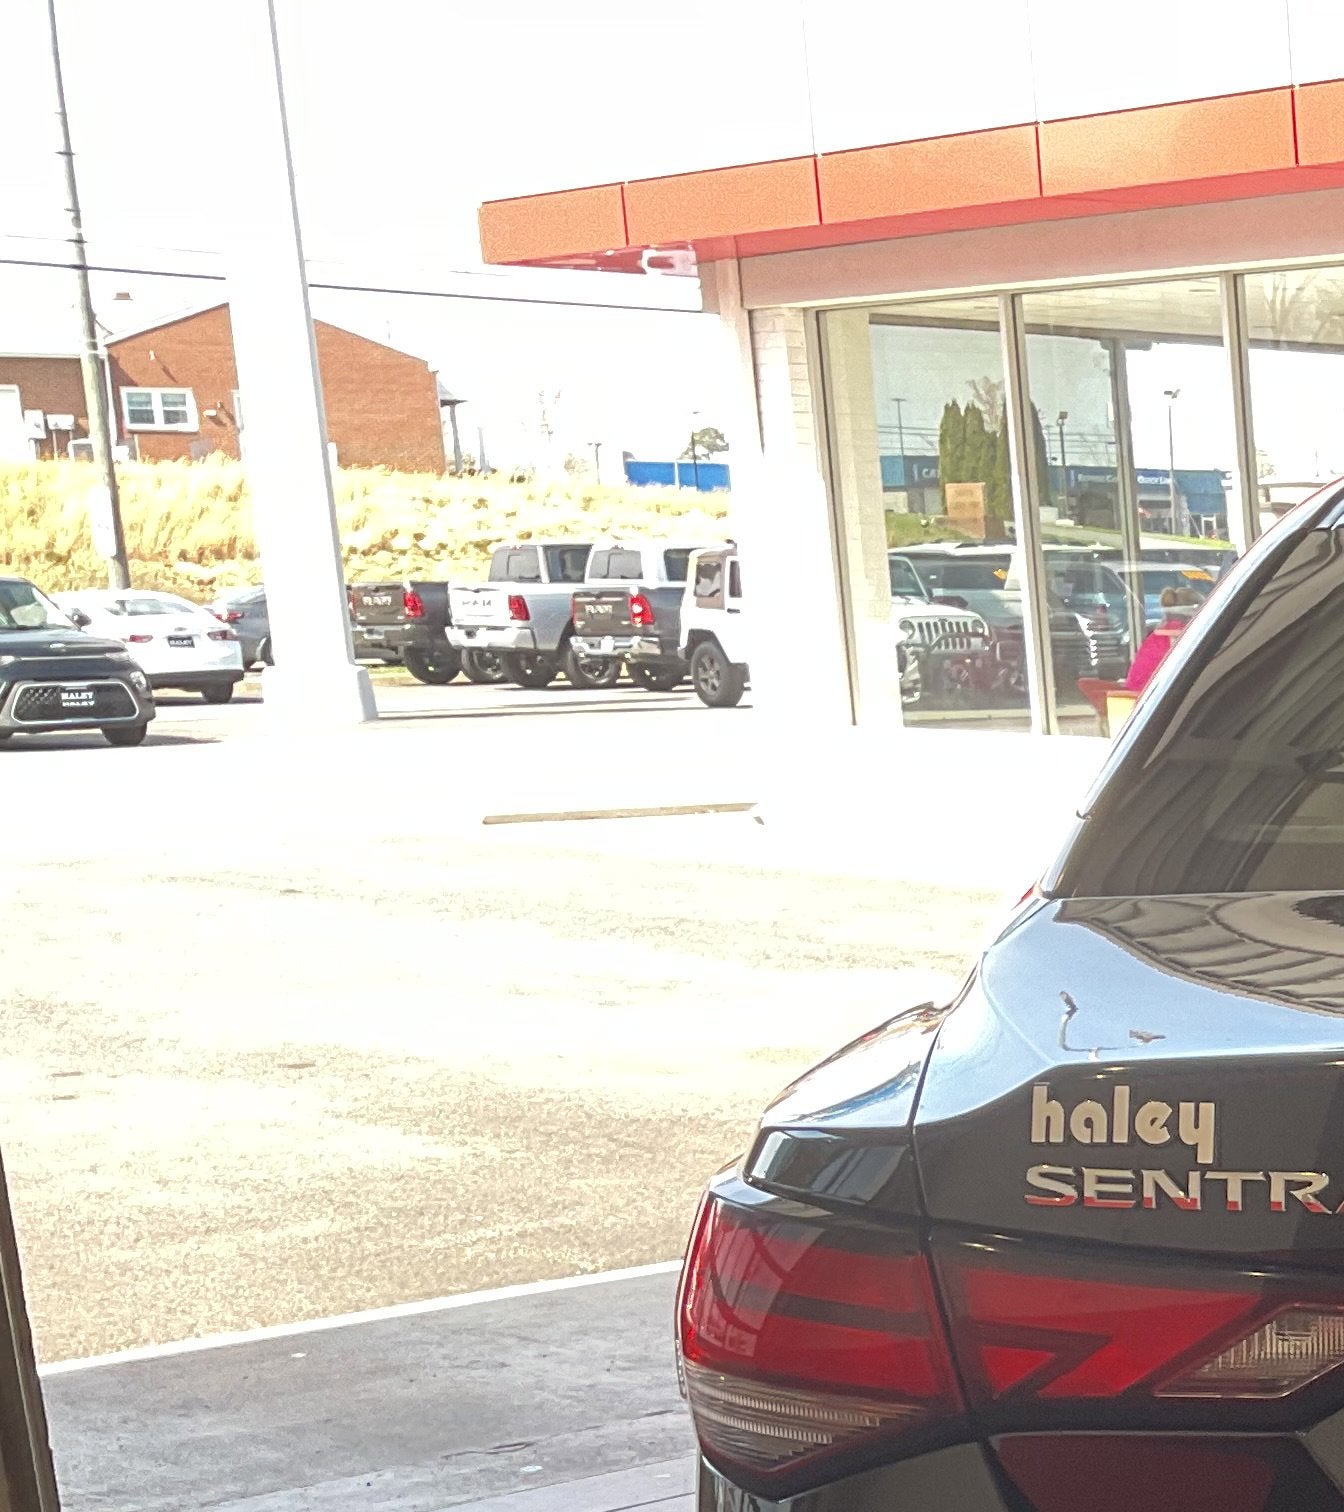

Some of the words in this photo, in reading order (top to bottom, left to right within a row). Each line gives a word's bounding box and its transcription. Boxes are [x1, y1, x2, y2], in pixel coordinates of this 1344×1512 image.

[361, 595, 392, 607] RAM
[584, 604, 613, 615] RAM
[60, 691, 94, 700] HALEY
[1030, 1084, 1216, 1164] haley
